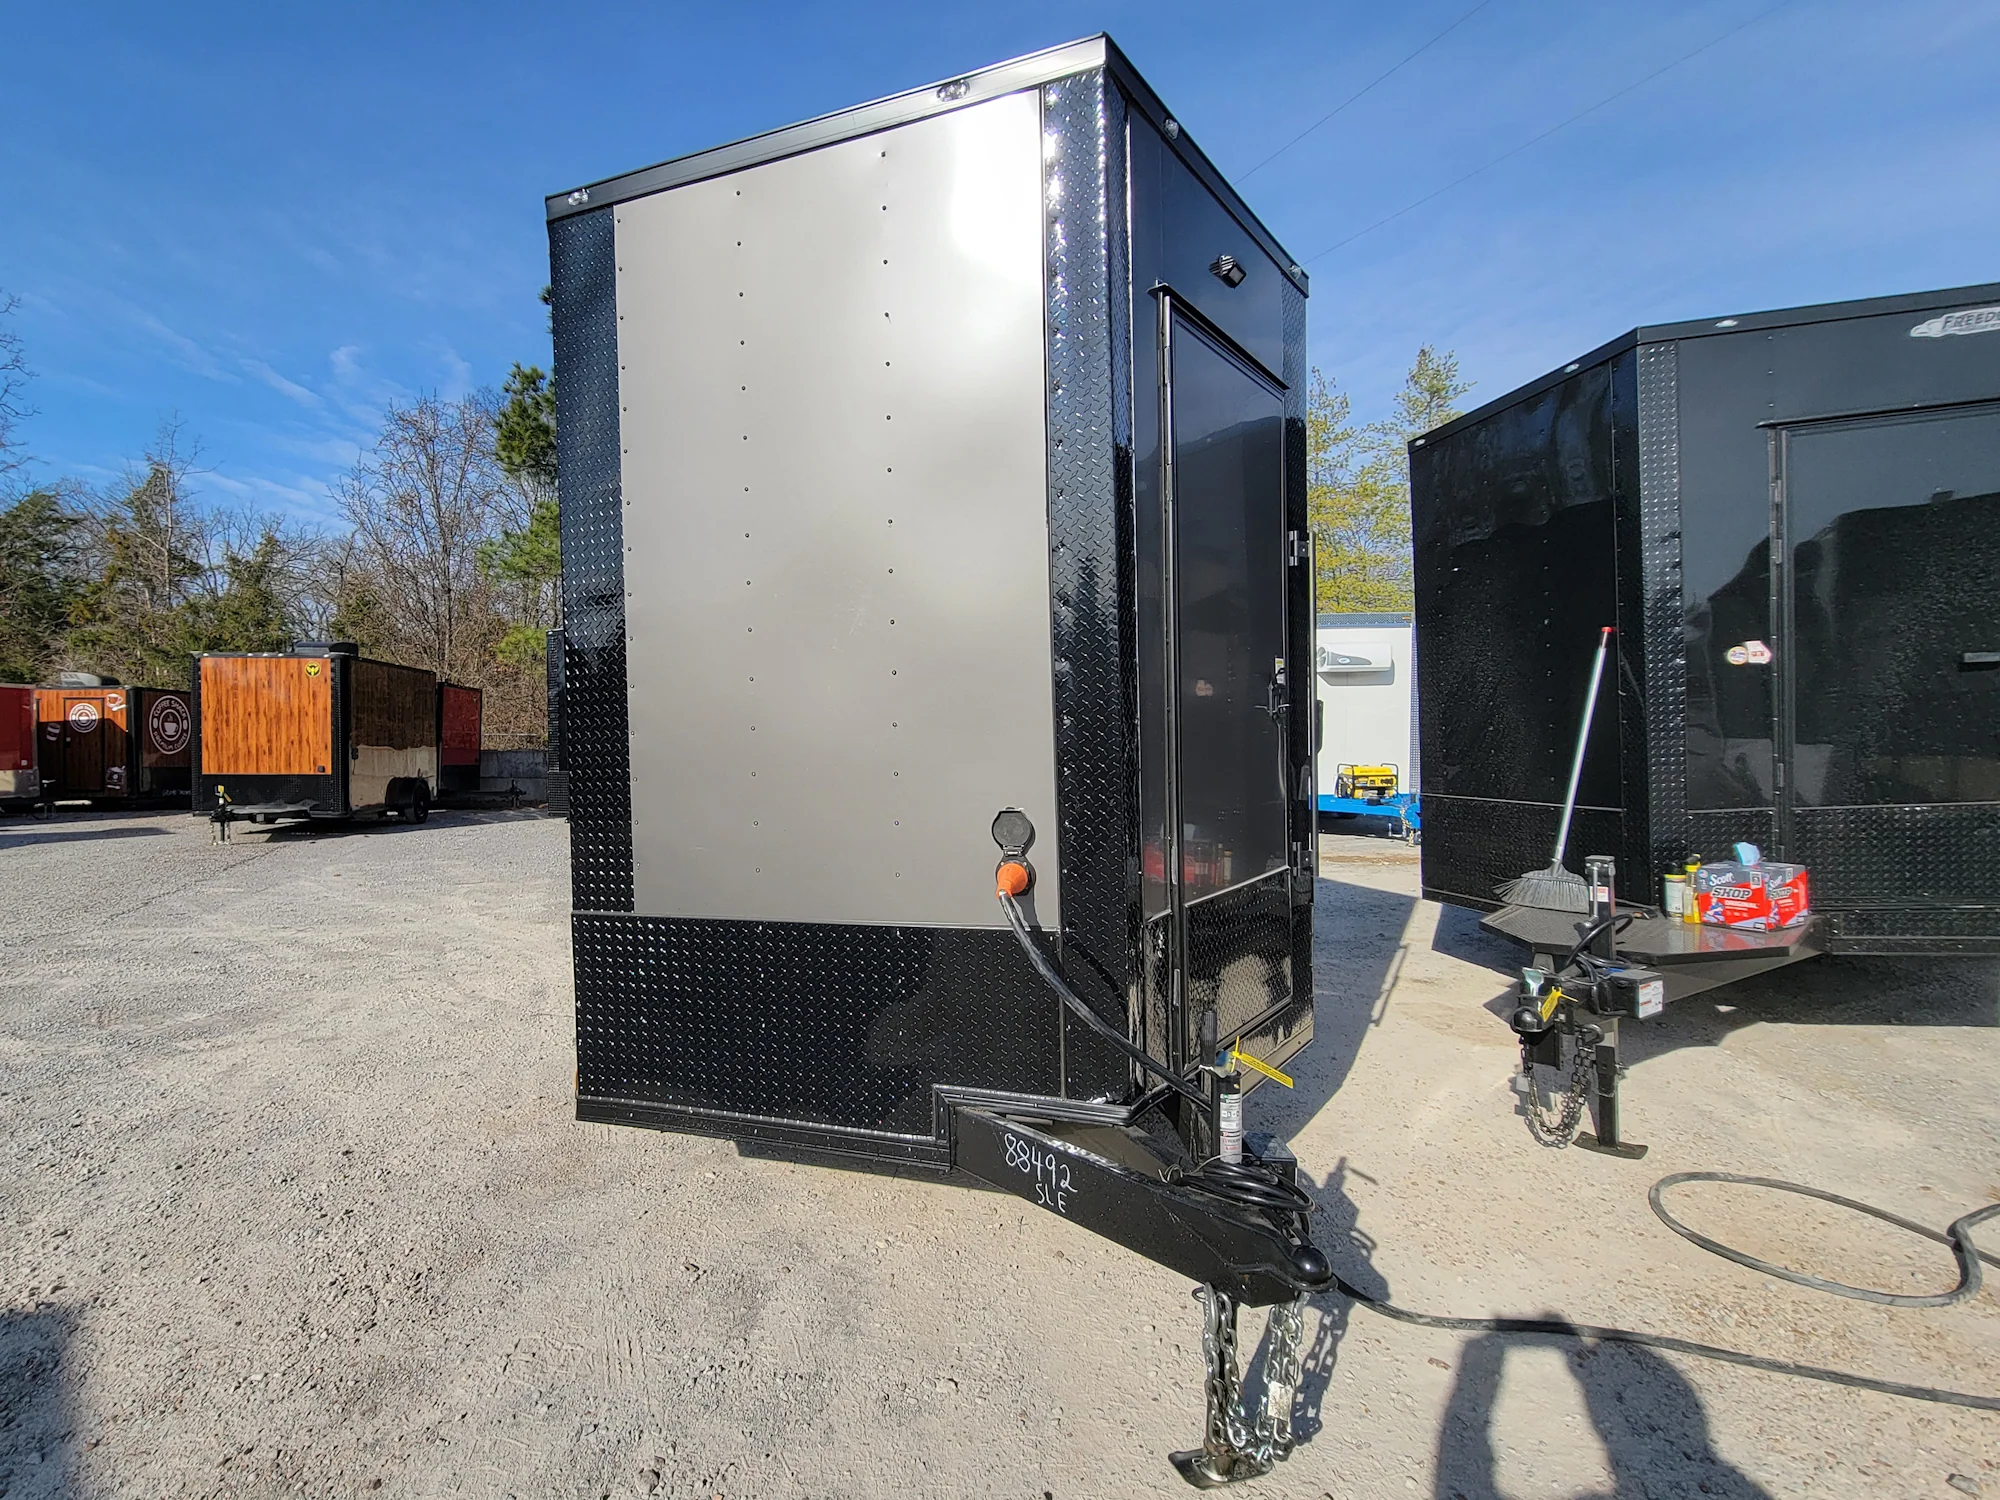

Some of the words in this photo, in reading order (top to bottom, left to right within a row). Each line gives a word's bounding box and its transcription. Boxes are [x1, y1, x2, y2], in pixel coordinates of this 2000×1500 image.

[153, 700, 170, 717] COFFEE
[170, 700, 187, 719] SHACK
[1709, 872, 1734, 886] Scott
[1711, 887, 1751, 899] SHOP
[1005, 1133, 1078, 1192] 88492
[1036, 1183, 1067, 1213] SLE
